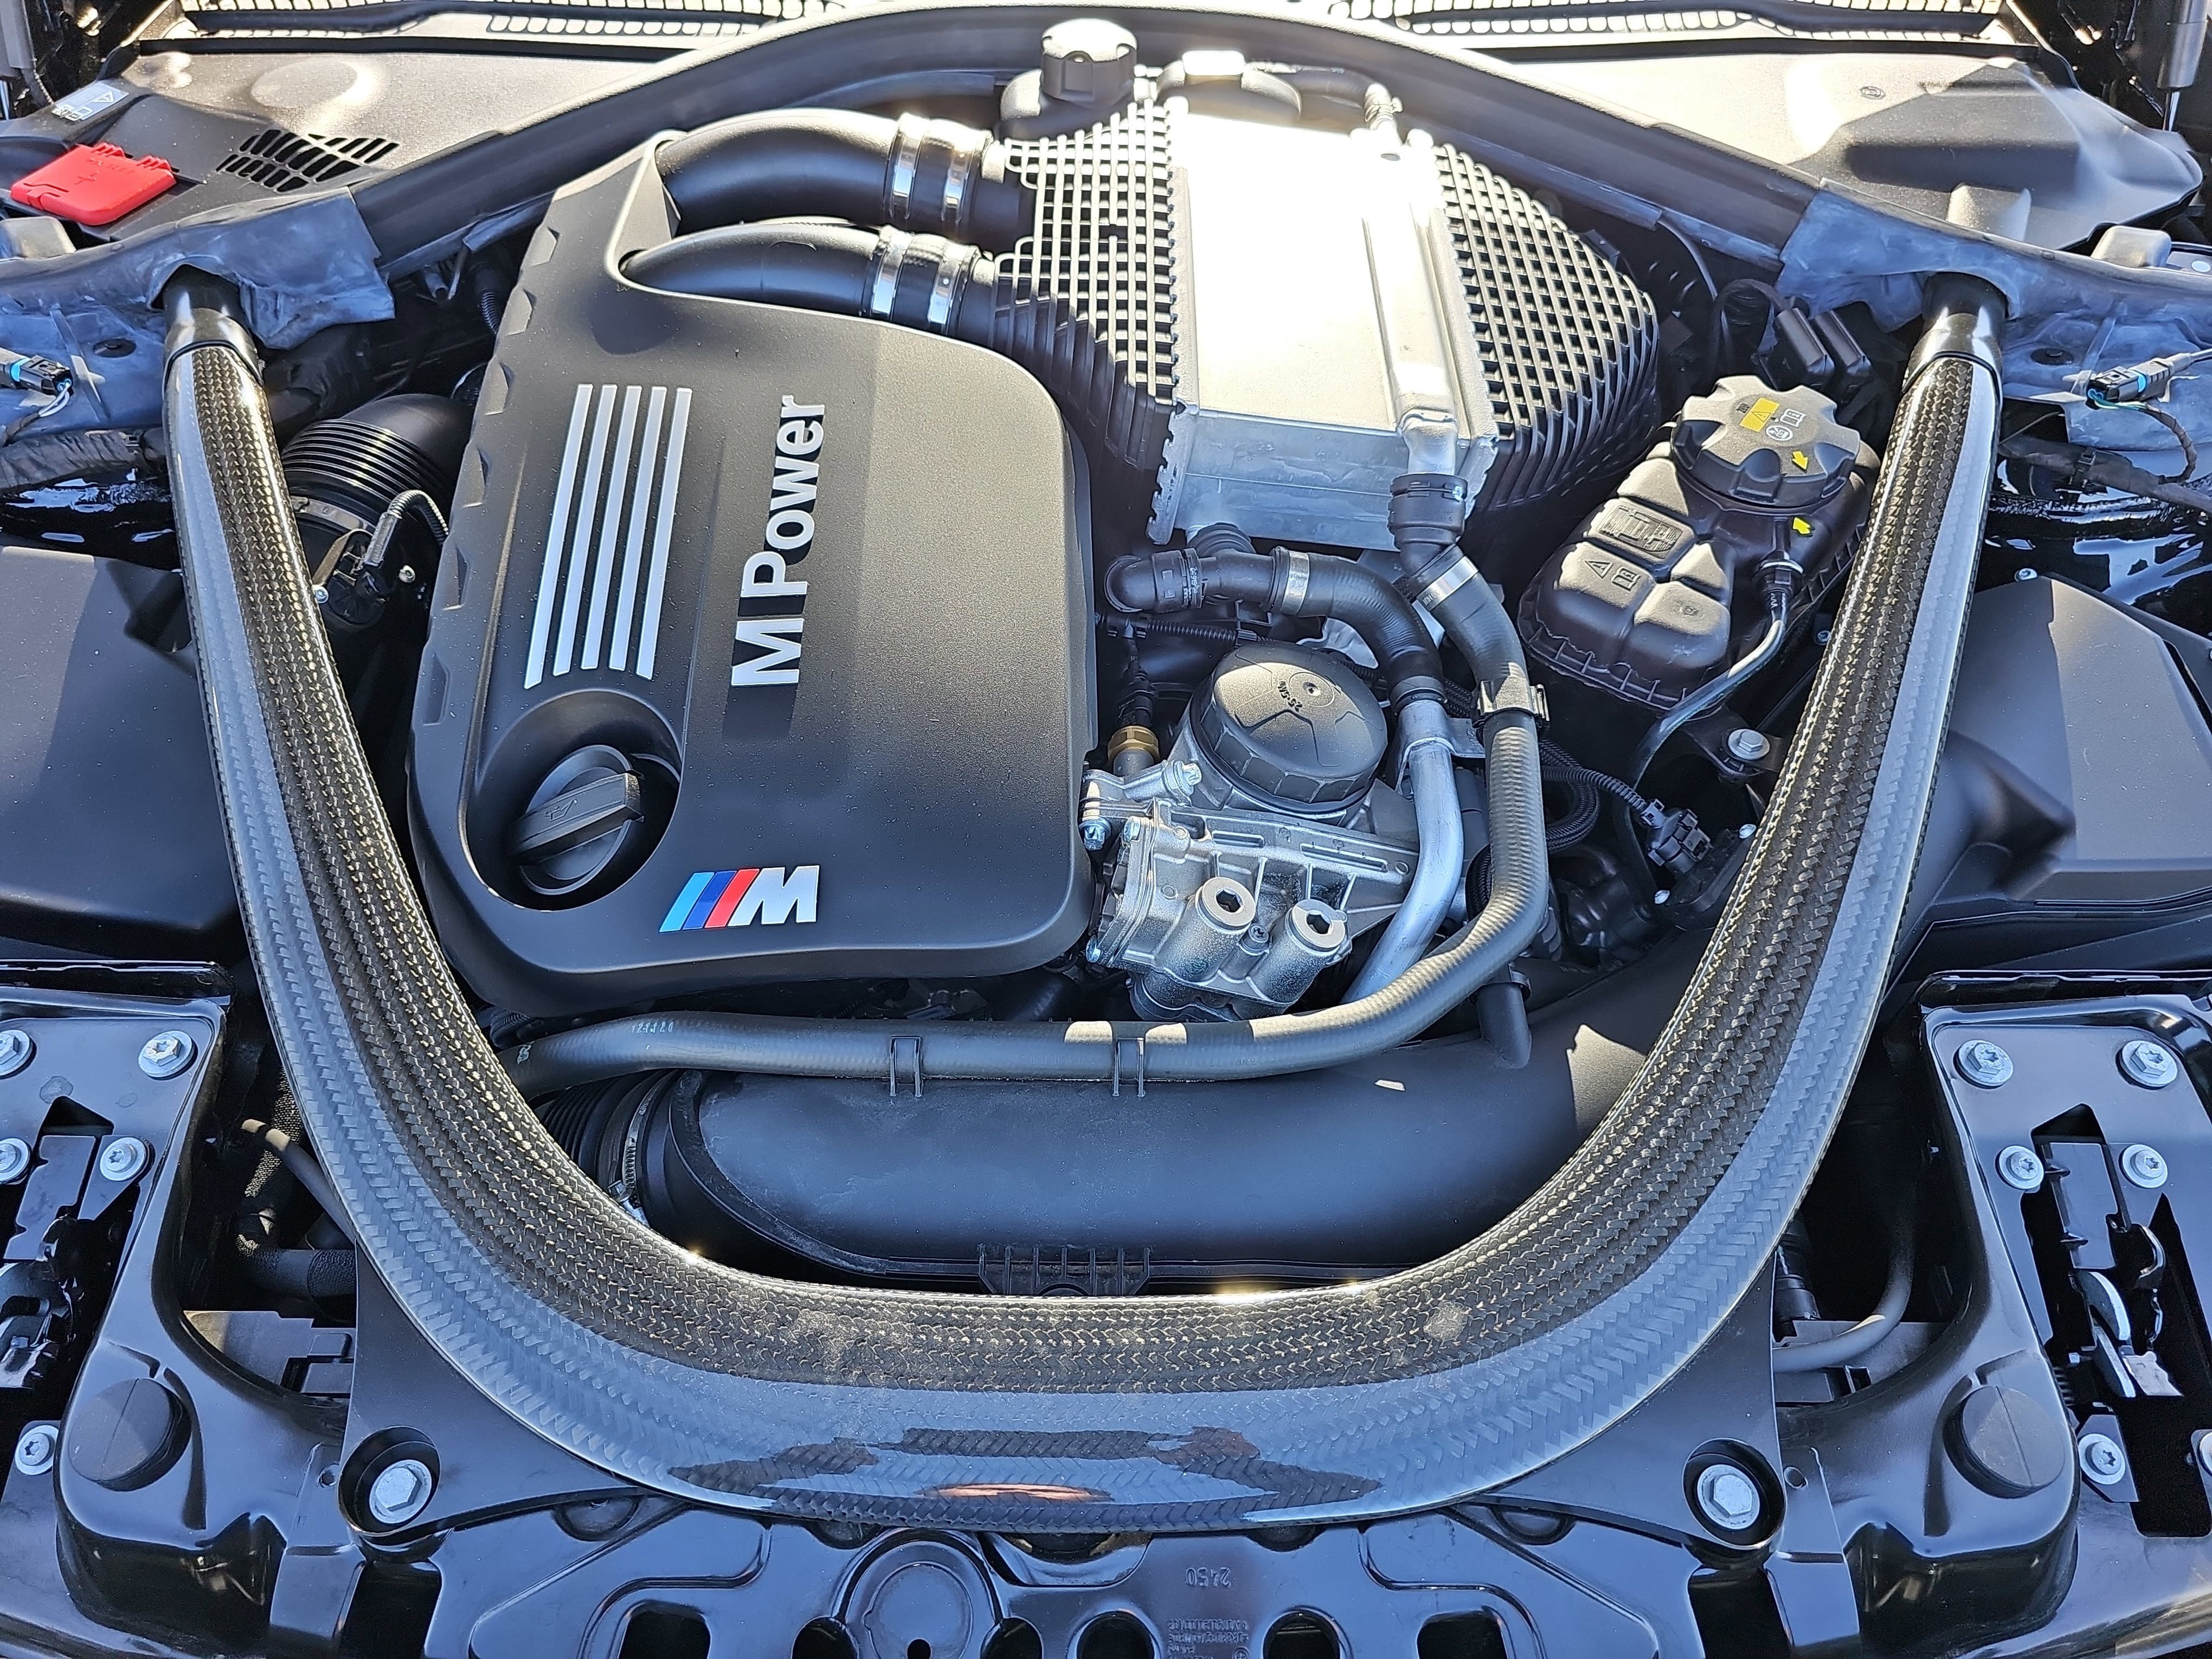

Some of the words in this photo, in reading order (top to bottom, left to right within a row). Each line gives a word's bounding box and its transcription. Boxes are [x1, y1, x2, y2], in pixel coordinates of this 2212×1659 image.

[741, 394, 825, 597] Power
[730, 618, 805, 687] M
[726, 865, 820, 927] M
[1185, 1566, 1232, 1588] 2450
